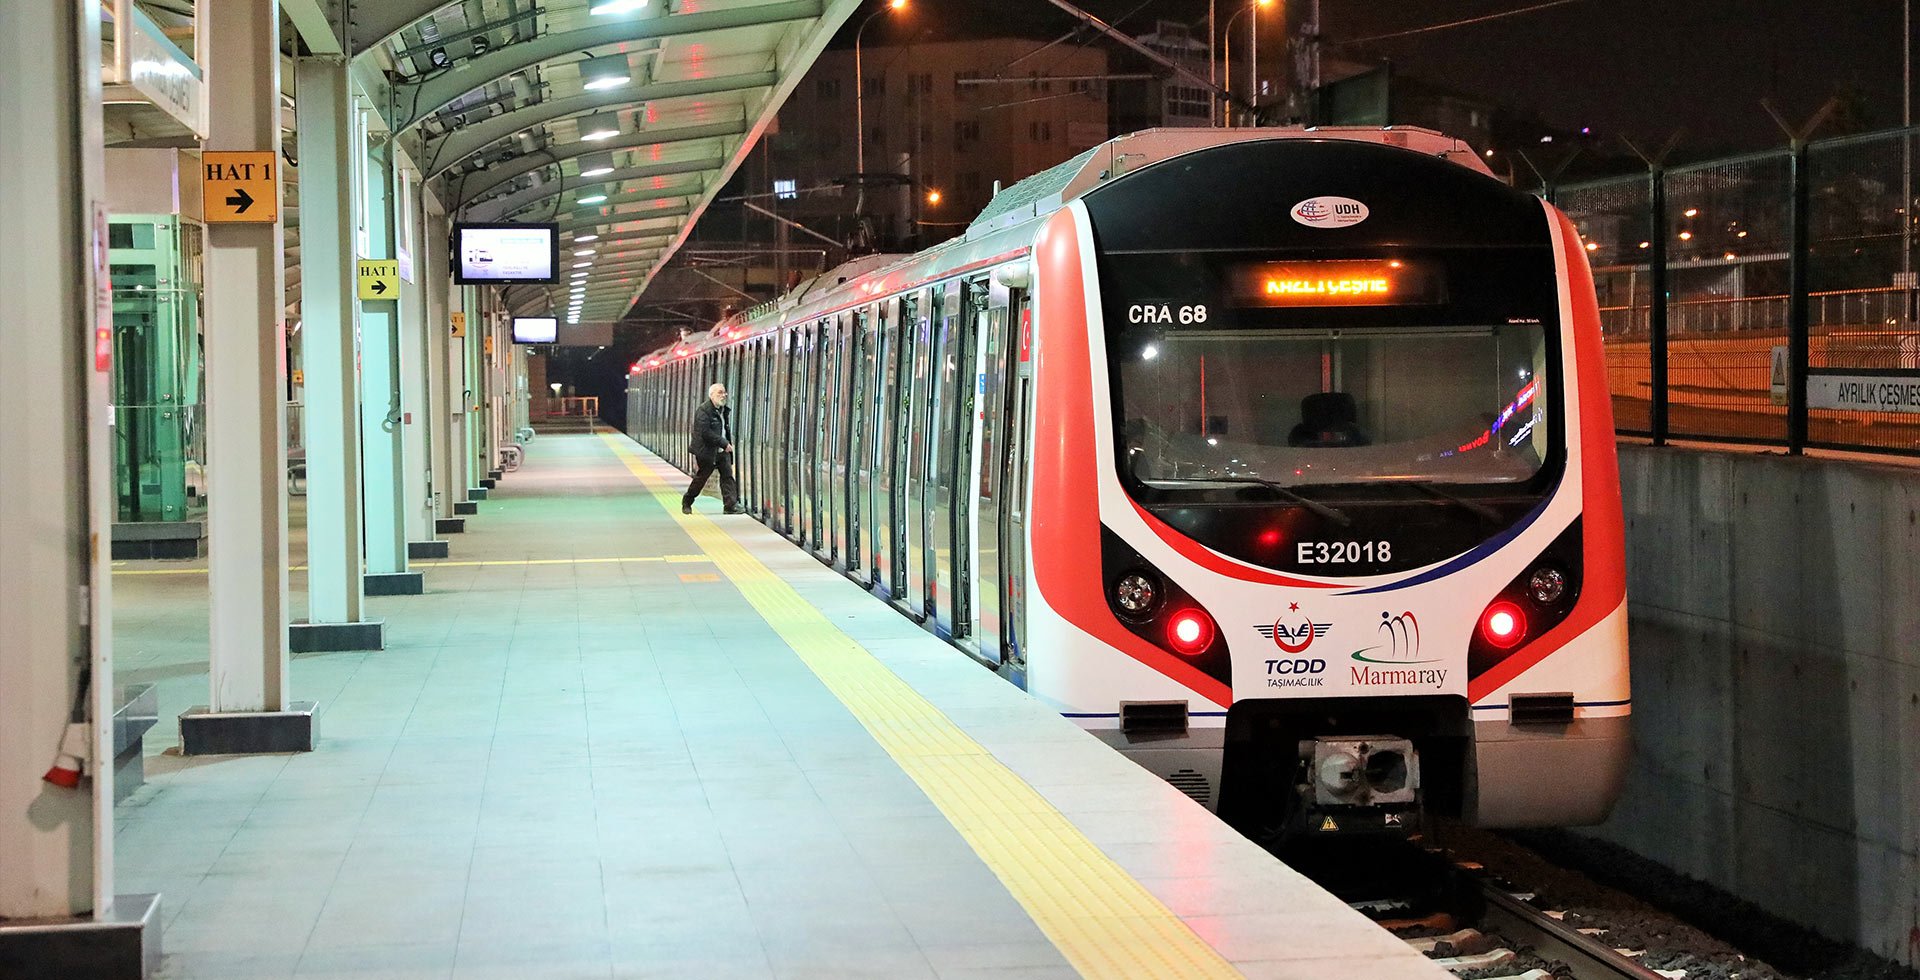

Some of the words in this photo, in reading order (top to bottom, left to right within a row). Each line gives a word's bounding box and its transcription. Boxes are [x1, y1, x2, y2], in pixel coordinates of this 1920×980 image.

[206, 164, 255, 180] HAT
[263, 164, 271, 180] 1
[1335, 204, 1360, 215] UDH
[361, 266, 387, 276] HAT
[392, 266, 396, 276] 1
[1128, 304, 1173, 324] CRA
[1179, 304, 1207, 325] 68
[1838, 382, 1876, 404] AYRILIK
[1297, 540, 1392, 564] E32018
[1265, 658, 1326, 675] TCDD
[1267, 677, 1324, 690] TAŞIMACILIK
[1350, 665, 1448, 689] Marmaray
